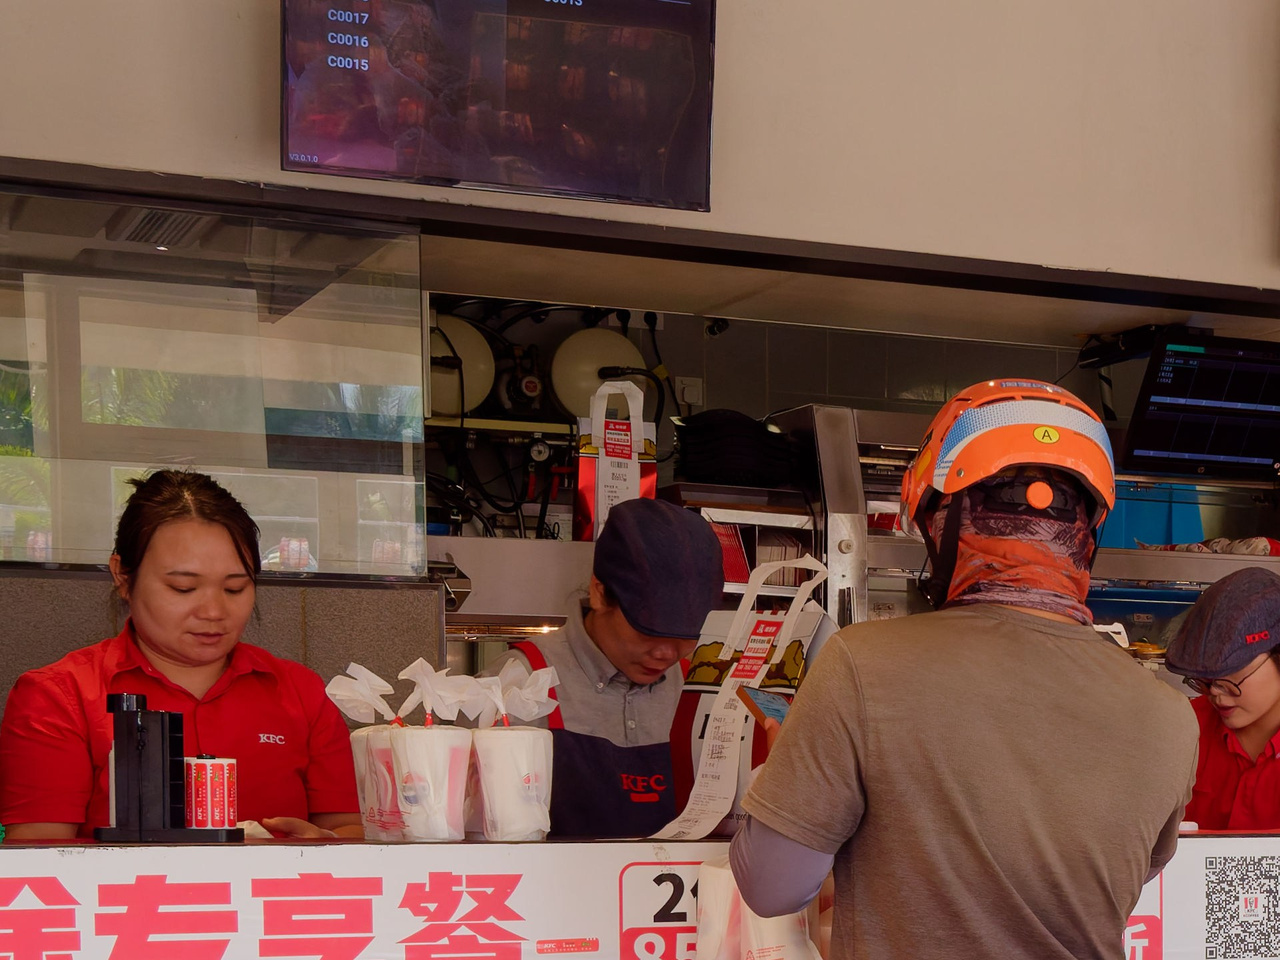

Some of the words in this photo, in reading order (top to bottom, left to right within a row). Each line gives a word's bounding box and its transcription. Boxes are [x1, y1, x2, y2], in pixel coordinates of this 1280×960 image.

[328, 9, 369, 25] C0017
[328, 32, 369, 48] C0016
[328, 55, 369, 71] C0015
[1041, 429, 1053, 441] A
[1245, 630, 1270, 645] KFC
[258, 733, 285, 745] KFC
[620, 773, 667, 792] KFC
